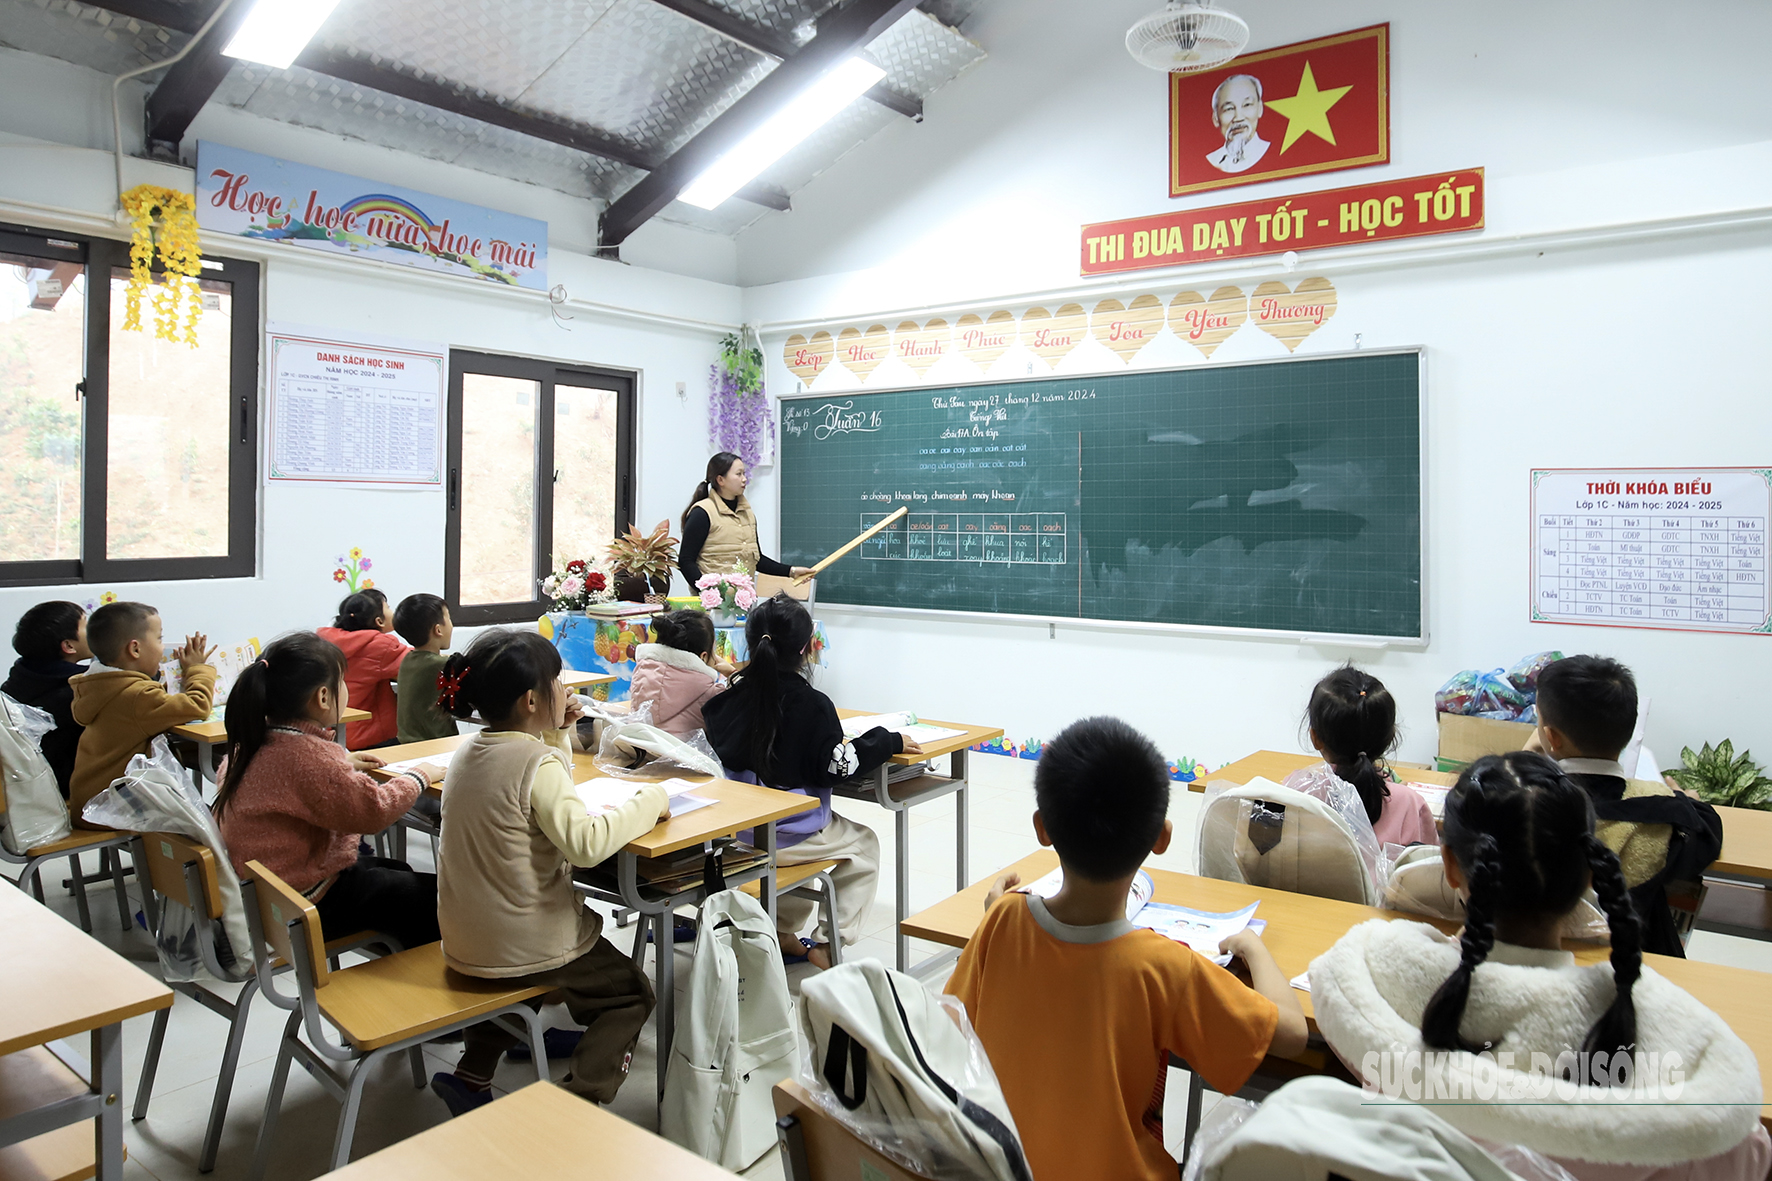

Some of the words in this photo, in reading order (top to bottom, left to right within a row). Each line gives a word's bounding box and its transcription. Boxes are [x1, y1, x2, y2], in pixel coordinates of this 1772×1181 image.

[210, 169, 291, 226] Học,
[303, 190, 355, 238] học
[438, 219, 482, 262] học
[491, 242, 537, 270] mãi
[1086, 236, 1124, 265] THI
[1132, 231, 1184, 258] ĐUA
[1193, 217, 1247, 255] DẠY
[1255, 201, 1308, 244] TỐT
[1340, 195, 1403, 237] HỌC
[1414, 176, 1476, 224] TỐT
[795, 349, 822, 370] Lớp
[849, 345, 877, 365] Học
[901, 340, 942, 360] Hạnh
[963, 329, 1006, 348] Phúc
[1034, 330, 1072, 348] Lan
[1184, 308, 1228, 340] Yêu
[1259, 297, 1325, 324] Thương
[317, 353, 340, 363] DANH
[343, 354, 365, 366] SÁCH
[366, 358, 384, 370] HỌC
[386, 360, 405, 370] SINH
[326, 366, 342, 374] NĂM
[343, 368, 358, 376] HỌC
[360, 370, 375, 378] 2024
[381, 372, 396, 380] 2025
[968, 397, 988, 412] ngày
[989, 395, 1000, 407] 27
[1004, 393, 1029, 407] tháng
[1031, 393, 1040, 402] 12
[1042, 394, 1064, 402] năm
[1068, 389, 1096, 401] 2024
[869, 410, 882, 427] 16
[1586, 479, 1620, 495] THỜI
[1626, 479, 1668, 495] KHÓA
[1674, 477, 1712, 495] BIỂU
[913, 490, 928, 503] lang
[972, 491, 990, 503] máy
[991, 489, 1015, 501] khoan
[1576, 501, 1593, 510] Lớp
[1597, 501, 1608, 509] 1C
[1618, 501, 1638, 510] Năm
[1642, 501, 1663, 511] học:
[1667, 501, 1689, 510] 2024
[1699, 501, 1722, 510] 2025
[1599, 519, 1603, 527] 2
[1675, 519, 1680, 527] 4
[1714, 520, 1719, 528] 5
[1751, 520, 1755, 528] 6
[1700, 533, 1719, 541] TNXH
[1700, 546, 1719, 554] TNXH
